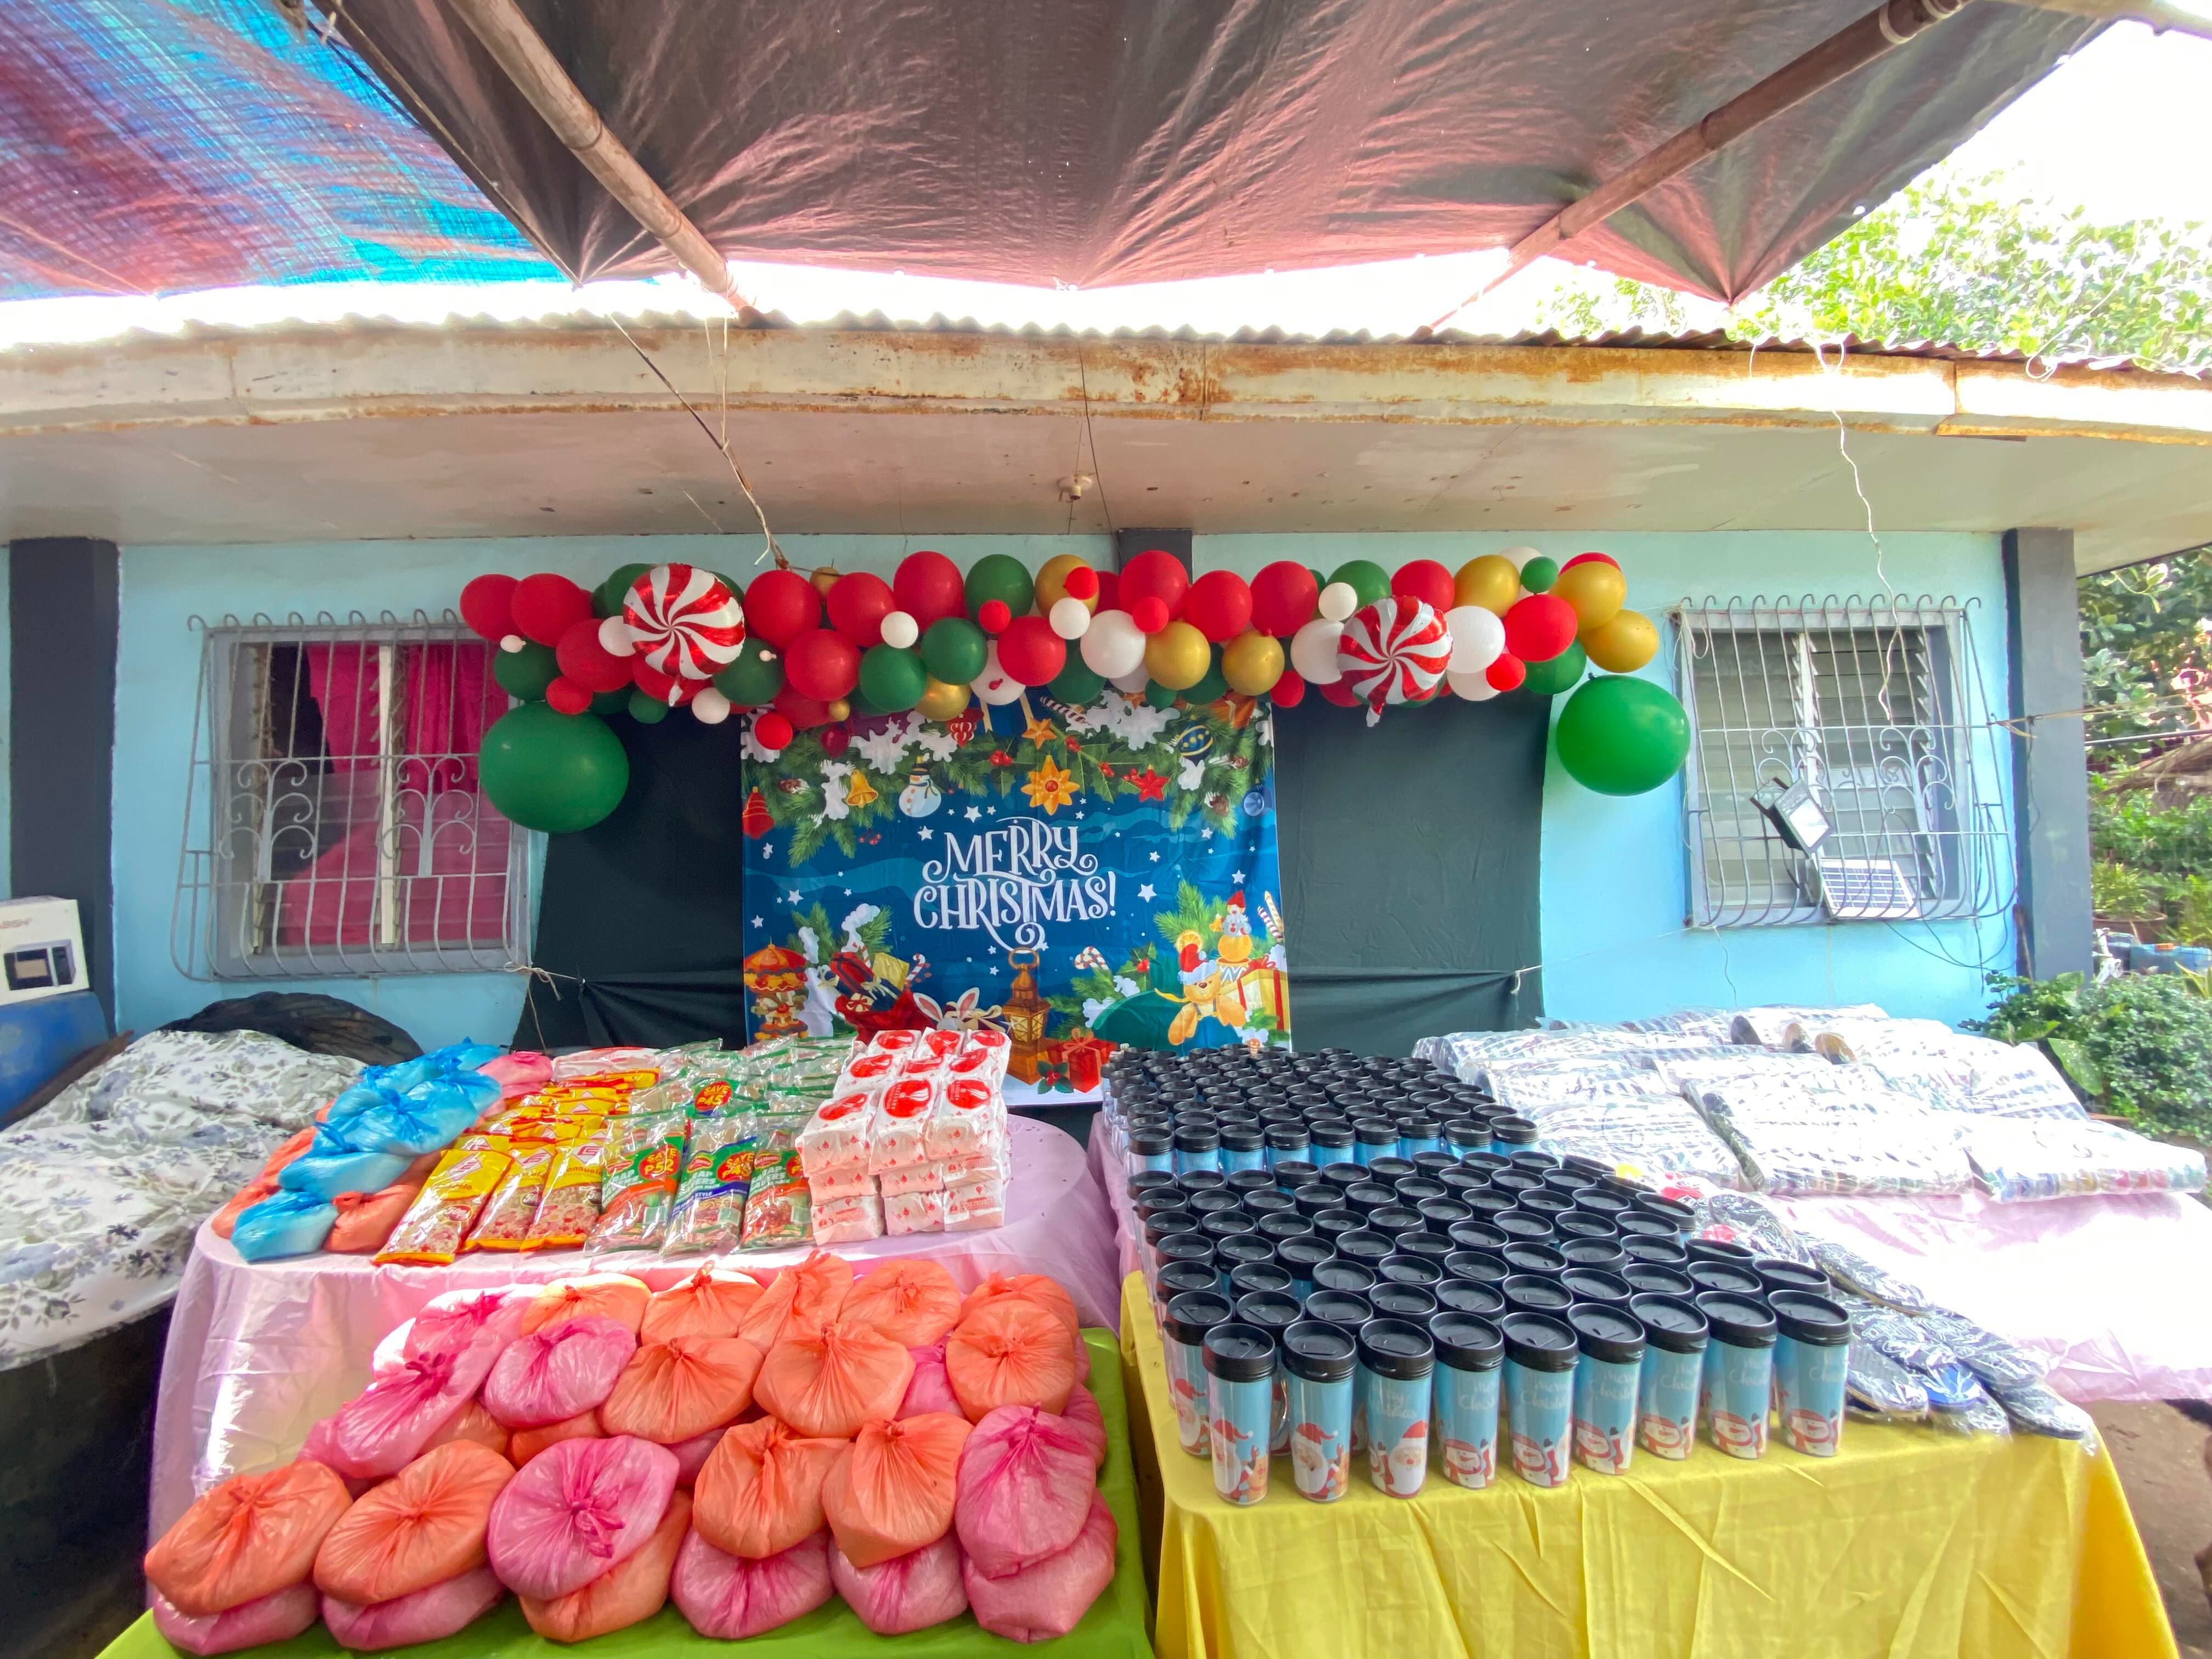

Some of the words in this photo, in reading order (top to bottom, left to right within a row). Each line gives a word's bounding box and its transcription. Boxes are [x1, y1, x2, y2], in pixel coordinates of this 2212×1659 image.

[922, 816, 1098, 884] MERRY
[913, 871, 1116, 953] CHRISTMAS!
[703, 1085, 730, 1096] SAVE
[726, 1153, 755, 1167] SAVE
